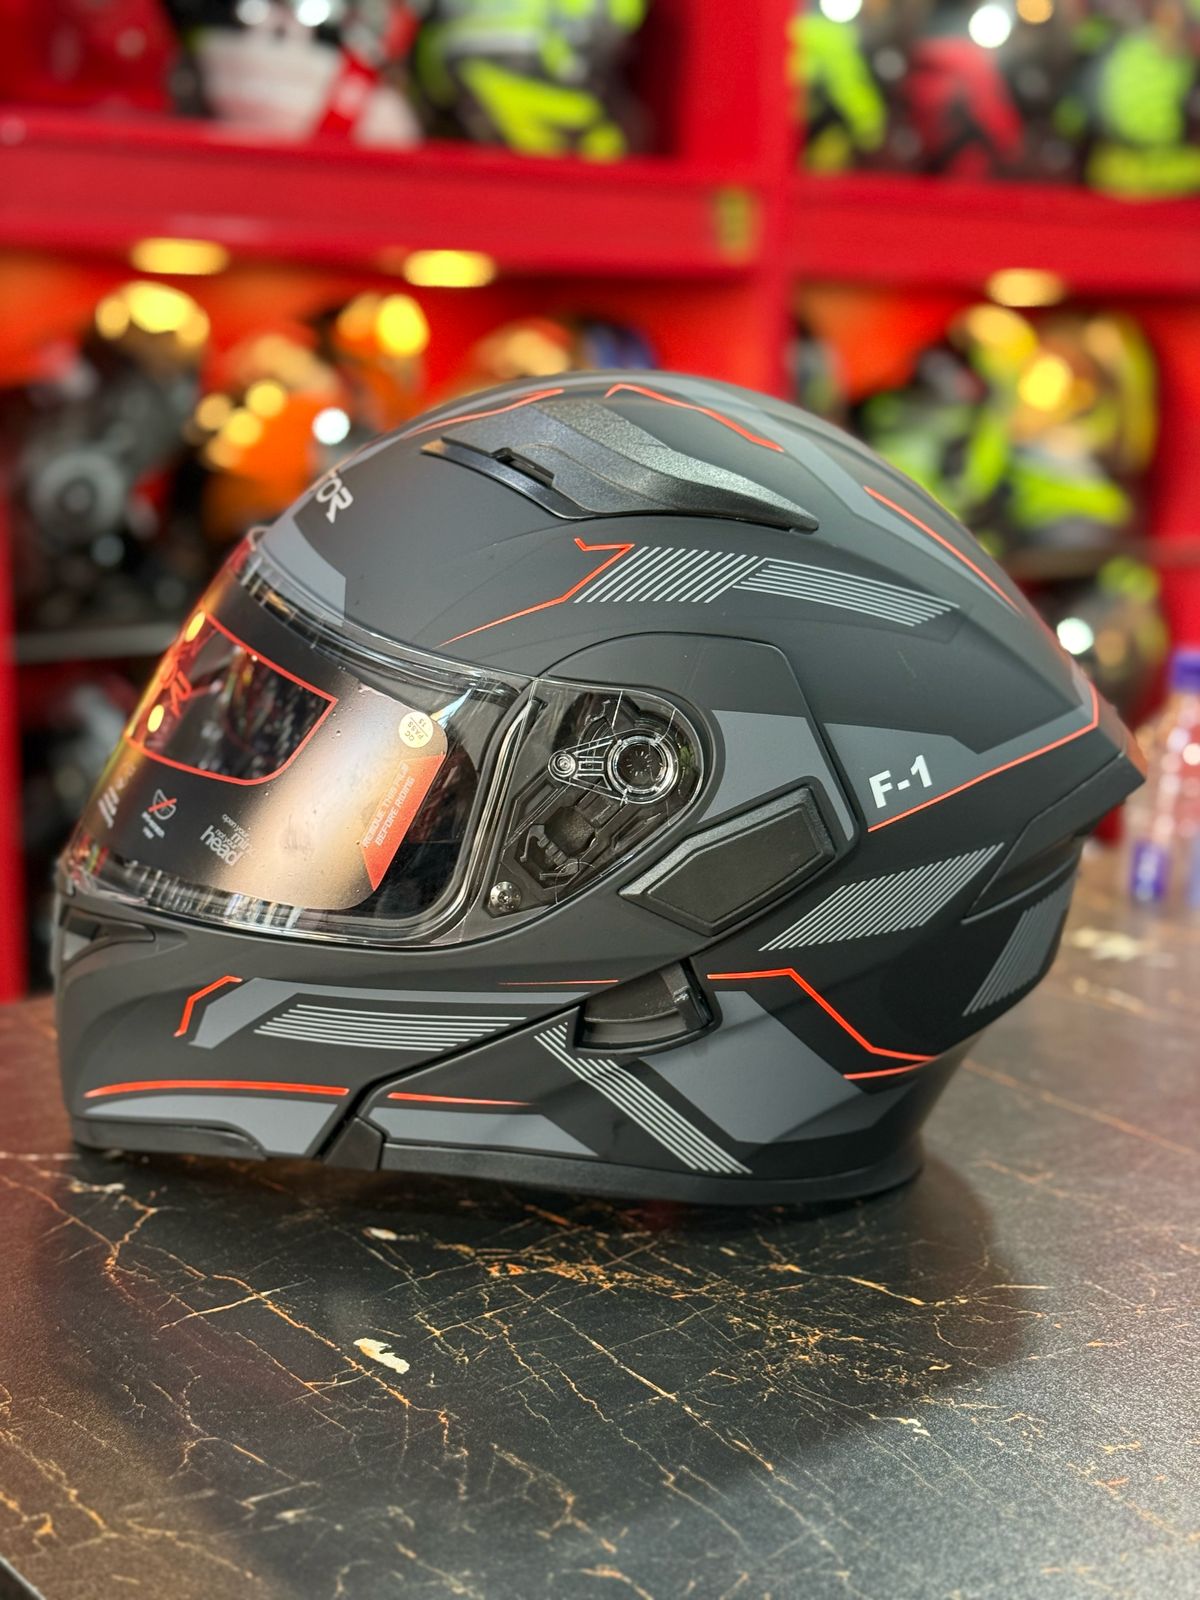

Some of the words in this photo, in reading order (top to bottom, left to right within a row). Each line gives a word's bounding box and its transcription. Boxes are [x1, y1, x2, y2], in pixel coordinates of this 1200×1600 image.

[310, 471, 354, 524] OR
[869, 754, 933, 809] F-1
[222, 814, 237, 829] open
[234, 825, 249, 838] your
[375, 807, 397, 846] BEFORE
[395, 776, 416, 808] RIDING
[200, 824, 244, 866] head
[215, 829, 227, 840] not
[222, 837, 238, 849] your
